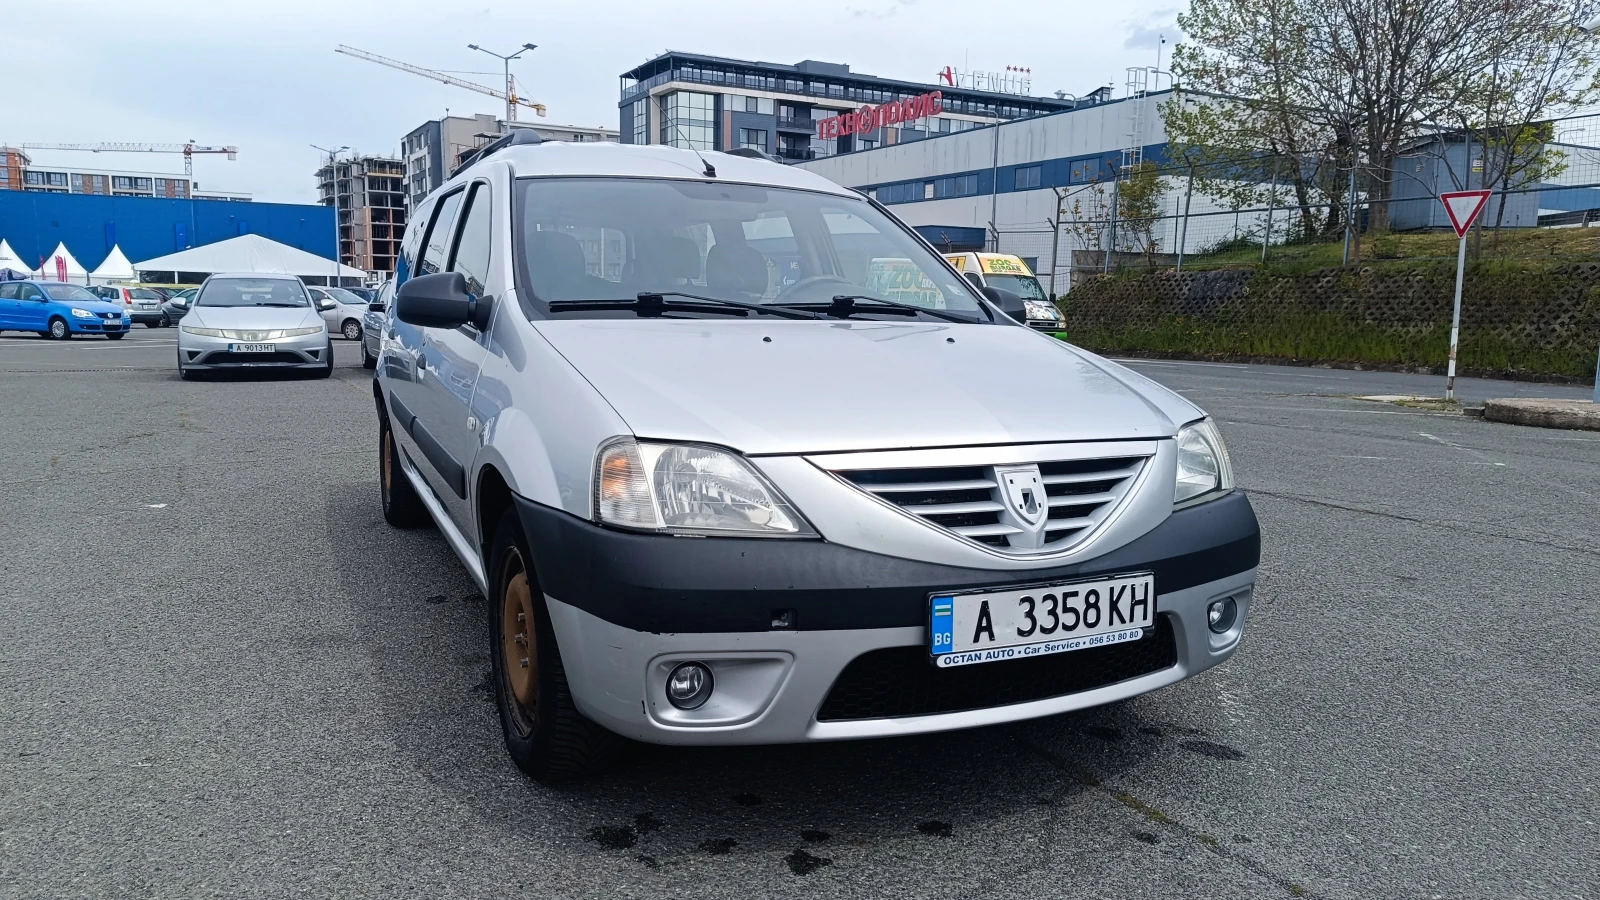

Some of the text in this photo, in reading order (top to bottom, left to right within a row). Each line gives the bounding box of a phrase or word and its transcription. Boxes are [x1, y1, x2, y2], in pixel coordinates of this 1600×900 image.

[936, 65, 1032, 96] AVENUE
[817, 90, 942, 140] ТЕХНОПОЛИС
[934, 632, 951, 646] BG
[972, 599, 996, 644] A
[943, 630, 1139, 666] OCTAN AUTO Car Service 056 53 80 80
